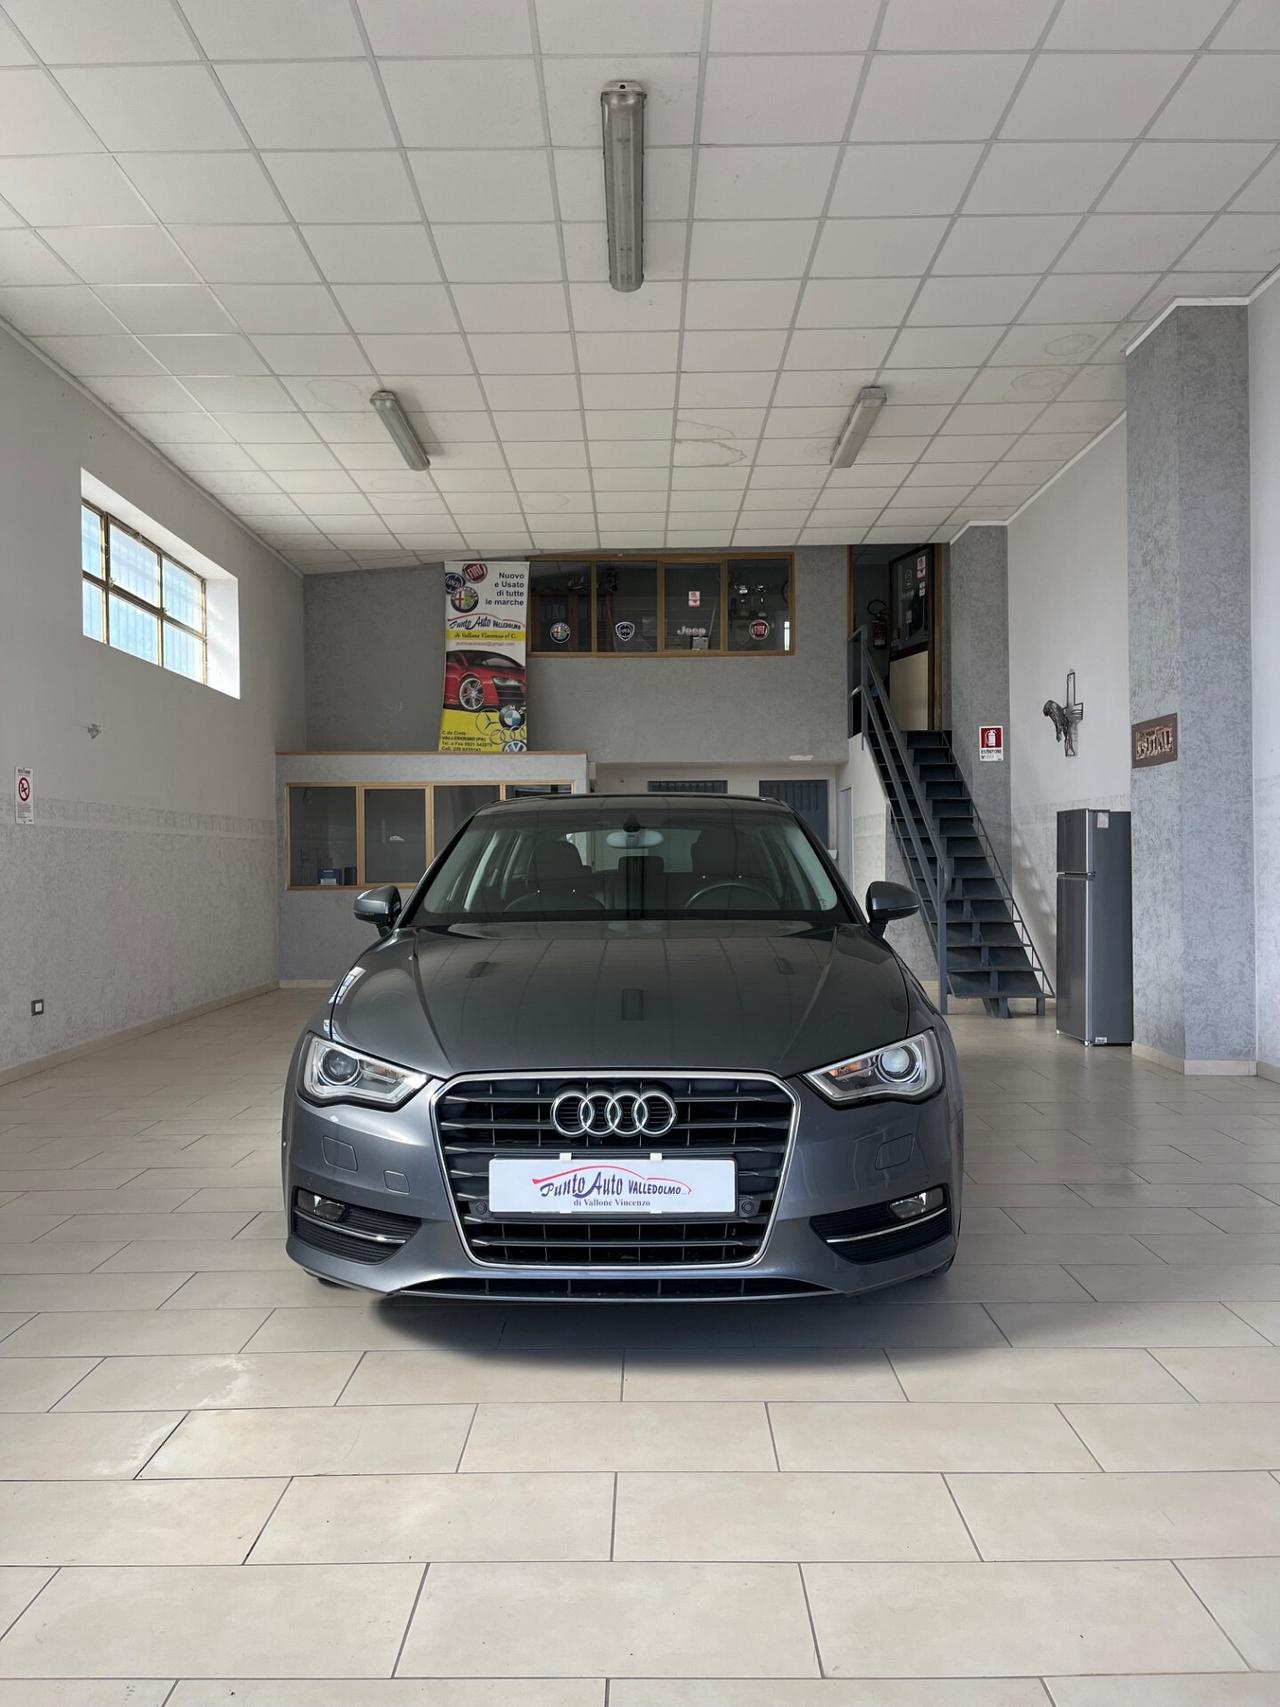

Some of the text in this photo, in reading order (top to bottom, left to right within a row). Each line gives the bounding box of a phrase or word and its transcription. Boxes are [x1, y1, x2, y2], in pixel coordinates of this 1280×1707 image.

[499, 572, 525, 580] Nuovo
[466, 616, 491, 630] Auto
[540, 1171, 681, 1198] Punto Auto VALLEDOLMO
